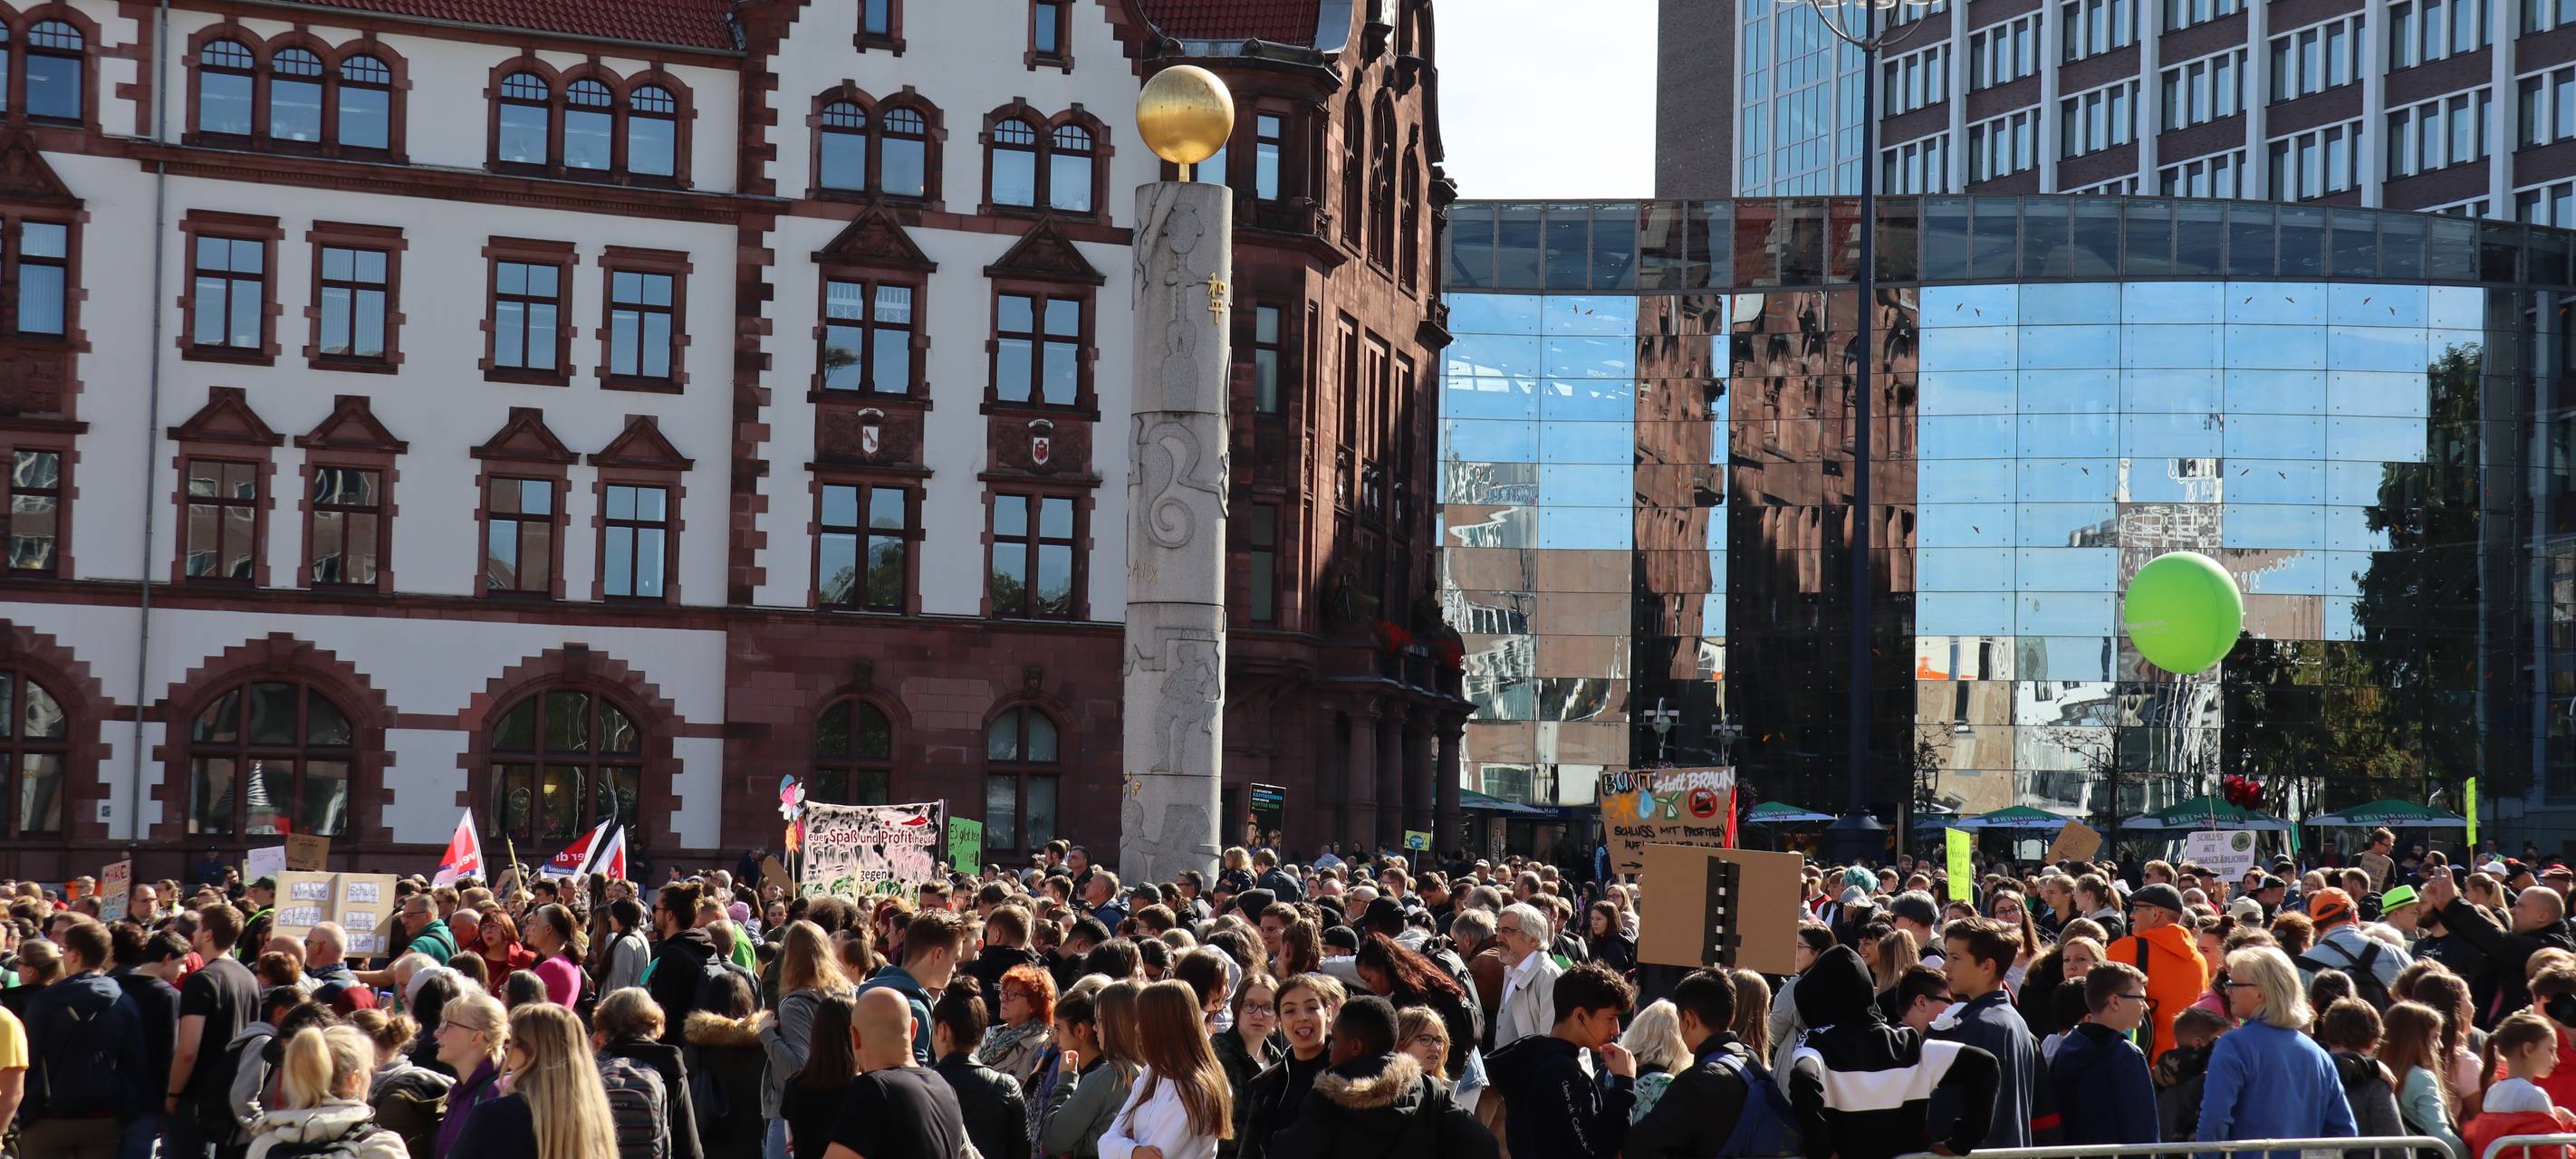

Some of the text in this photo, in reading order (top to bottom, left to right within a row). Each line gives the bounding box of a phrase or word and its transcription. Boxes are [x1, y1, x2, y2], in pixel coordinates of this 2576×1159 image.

[1602, 768, 1735, 797] BUNT statt BRAUN
[808, 833, 828, 842] euer
[830, 829, 858, 845] Spaß
[860, 830, 879, 843] und
[881, 830, 913, 844] Profit
[1614, 825, 1725, 838] SCHLUSS MIT PROFITEN
[860, 869, 888, 882] gegen
